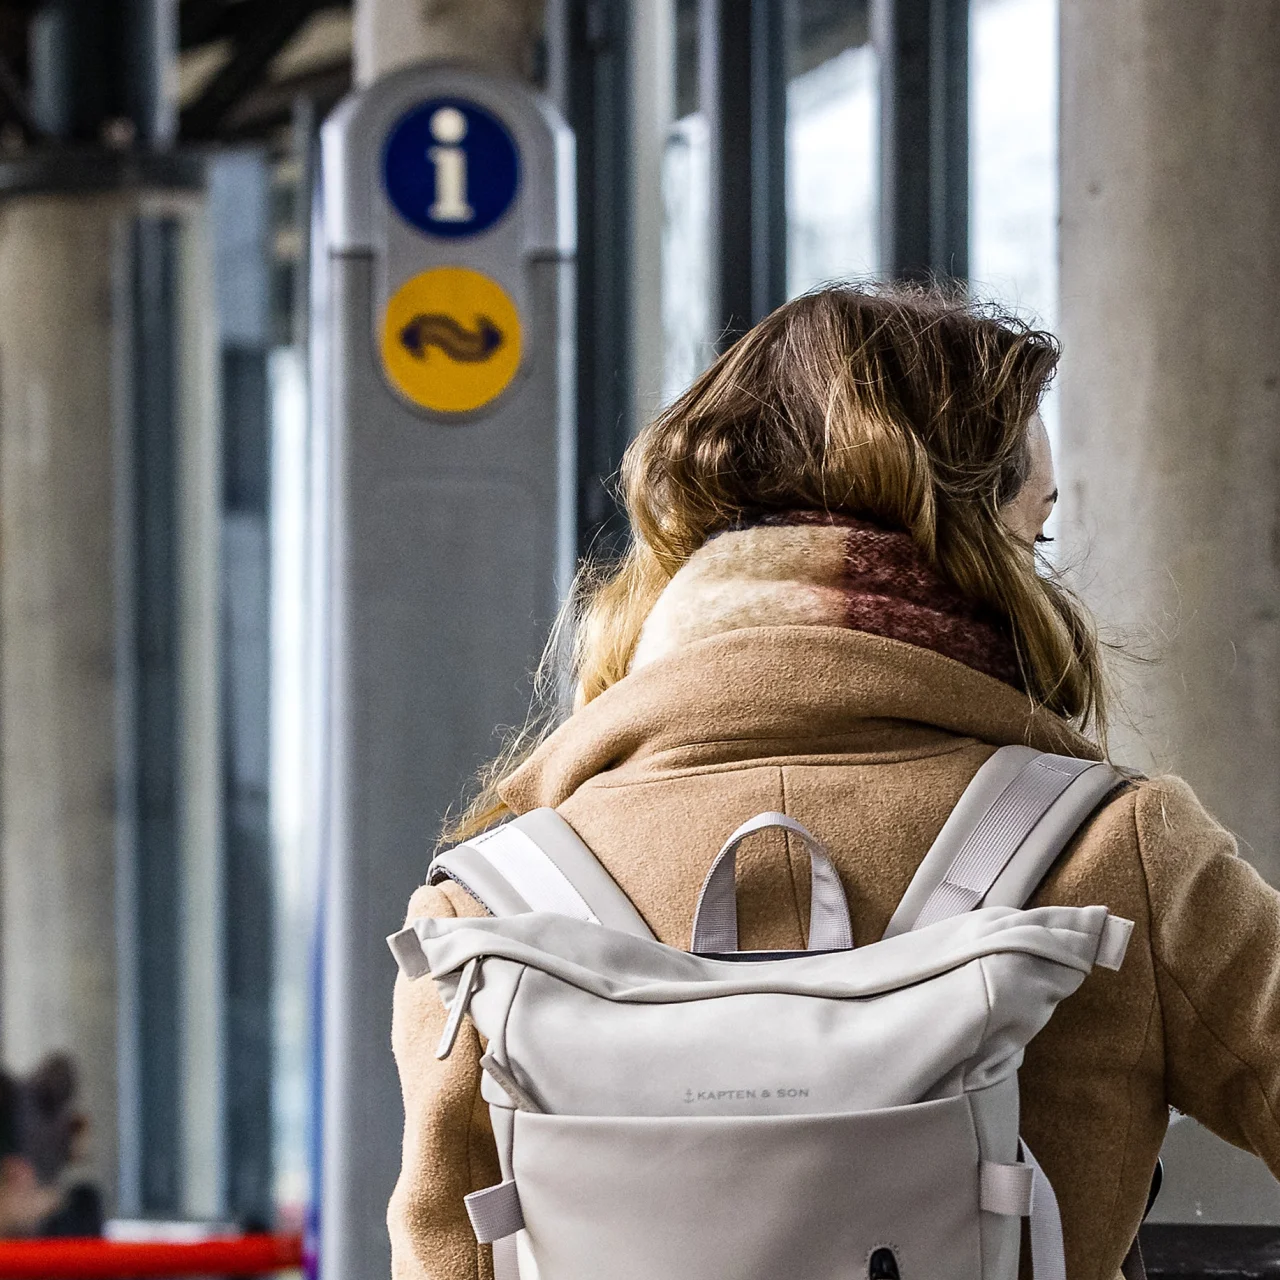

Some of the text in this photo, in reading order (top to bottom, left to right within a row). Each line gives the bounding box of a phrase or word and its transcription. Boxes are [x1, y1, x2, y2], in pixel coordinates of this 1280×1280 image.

[426, 106, 476, 223] i
[696, 1087, 810, 1101] KAPTEN & SON
